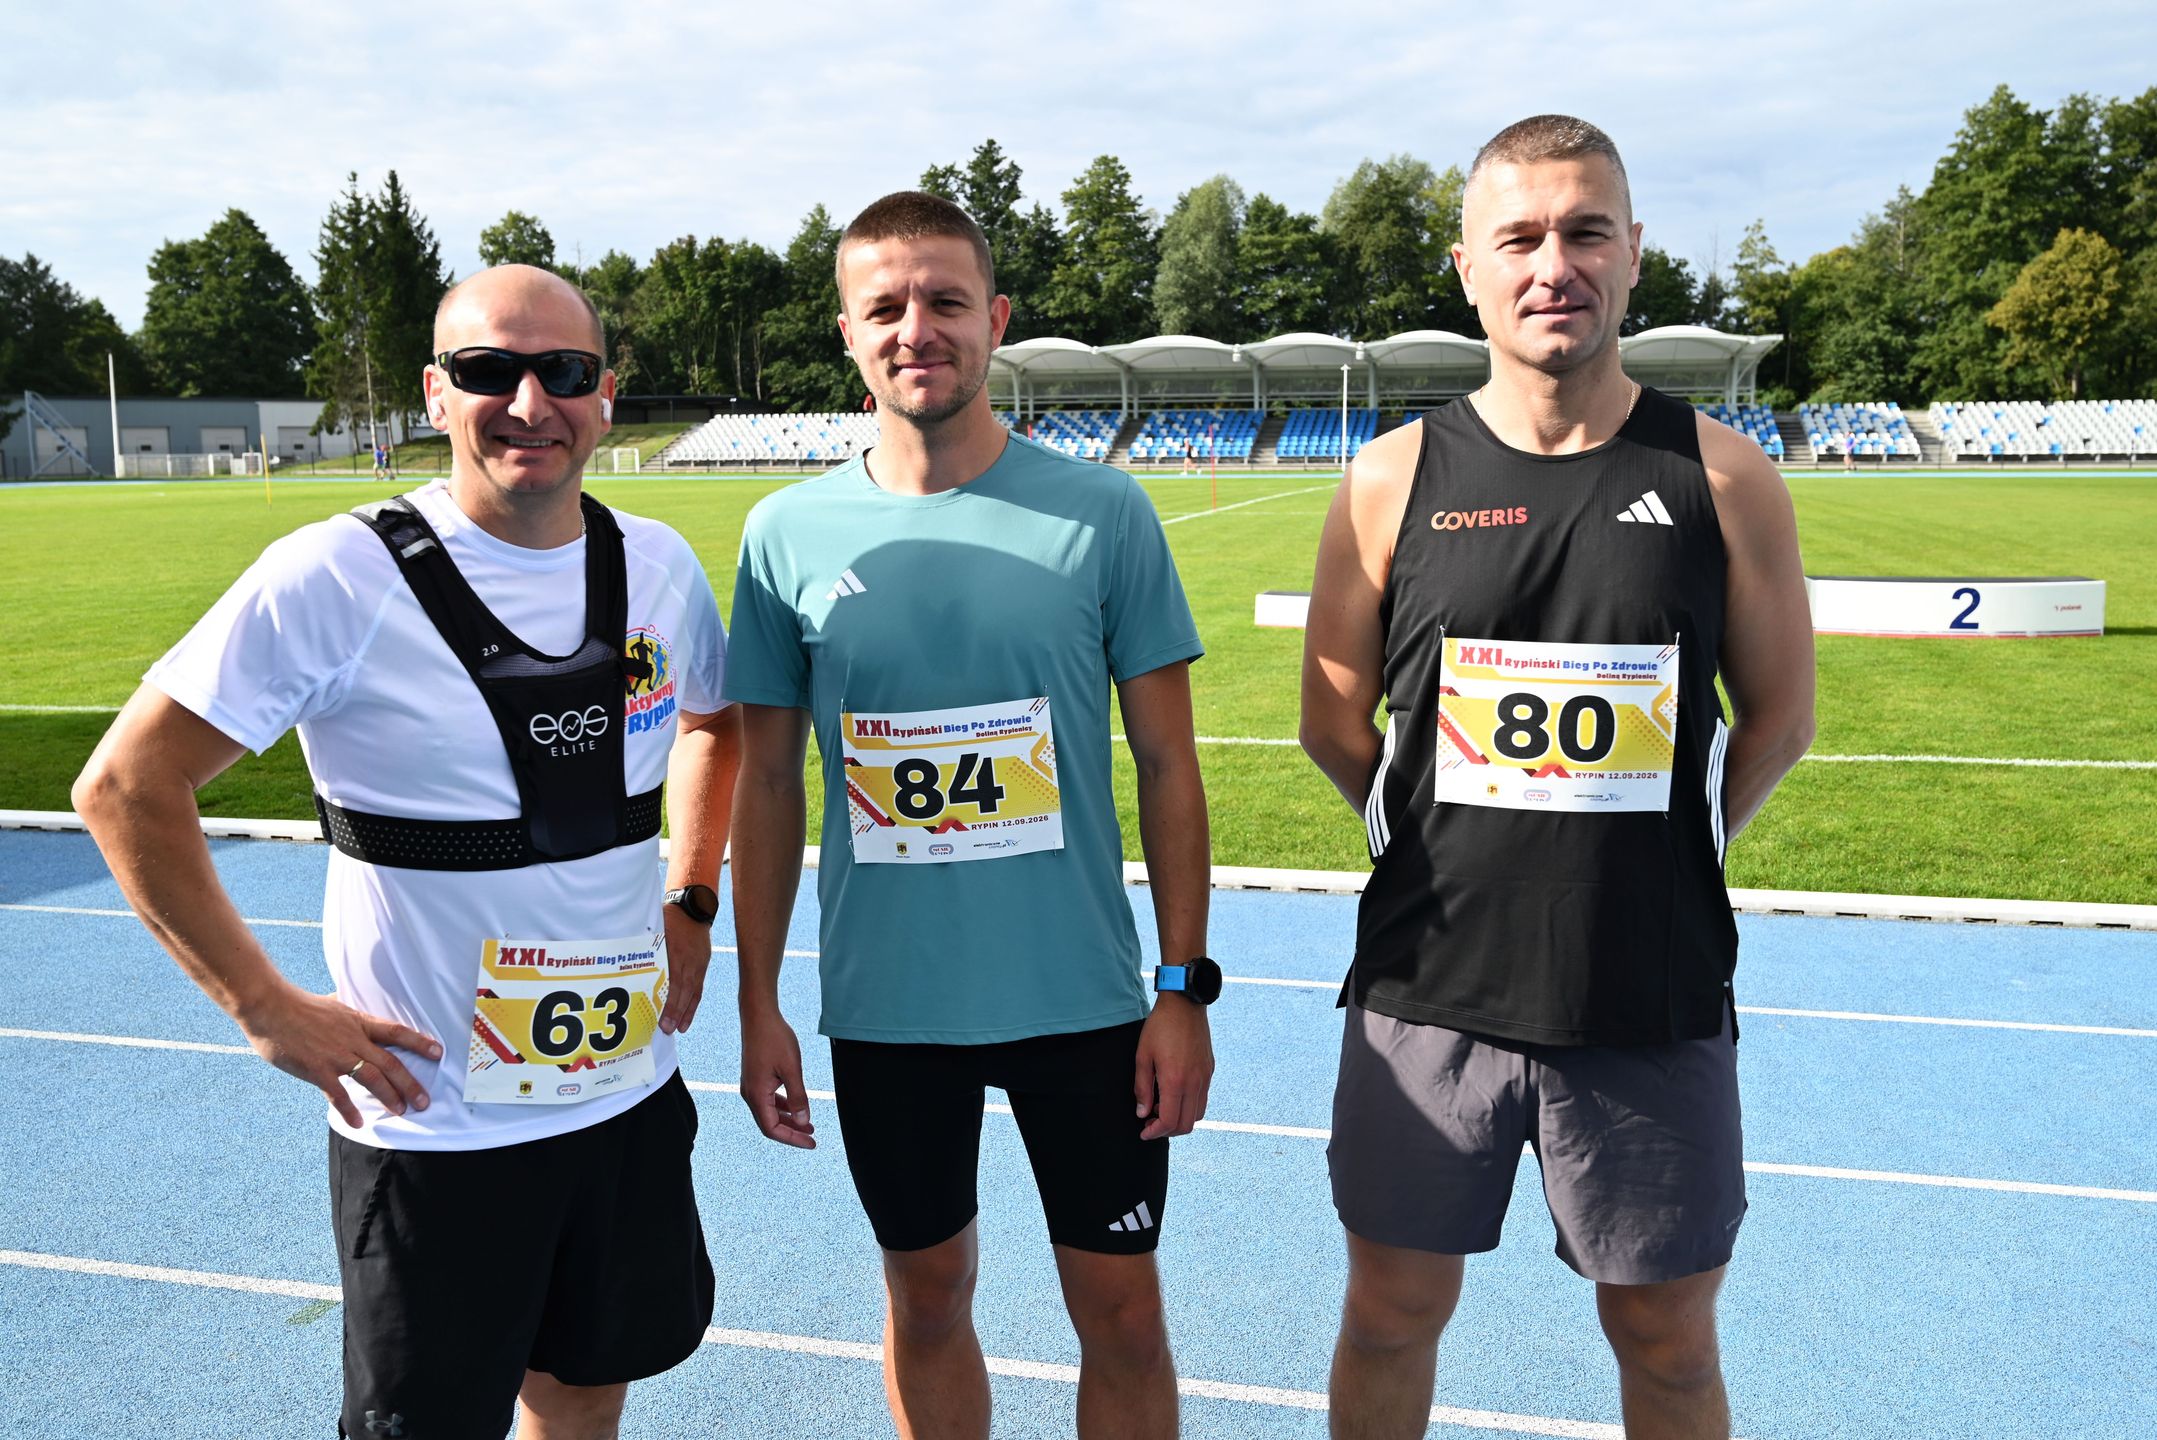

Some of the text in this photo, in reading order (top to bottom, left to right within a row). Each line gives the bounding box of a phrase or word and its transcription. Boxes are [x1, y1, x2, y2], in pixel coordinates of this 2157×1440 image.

[1431, 507, 1528, 531] COVERIS
[1949, 587, 1981, 629] 2
[482, 644, 499, 657] 2.0
[1459, 646, 1658, 671] XXI Rypiński Bieg Po Zdrowie
[855, 715, 1032, 738] XXI Rypiński Bieg Po Zdrowie
[1494, 692, 1615, 763] 80
[551, 740, 597, 757] ELITE
[893, 752, 1005, 820] 84
[971, 815, 1049, 831] RYPIN 12.09.2026
[499, 947, 546, 966] XXI
[547, 956, 596, 968] Rypiński
[597, 955, 616, 966] Bieg
[627, 951, 655, 961] Zdrowie
[532, 987, 631, 1057] 63
